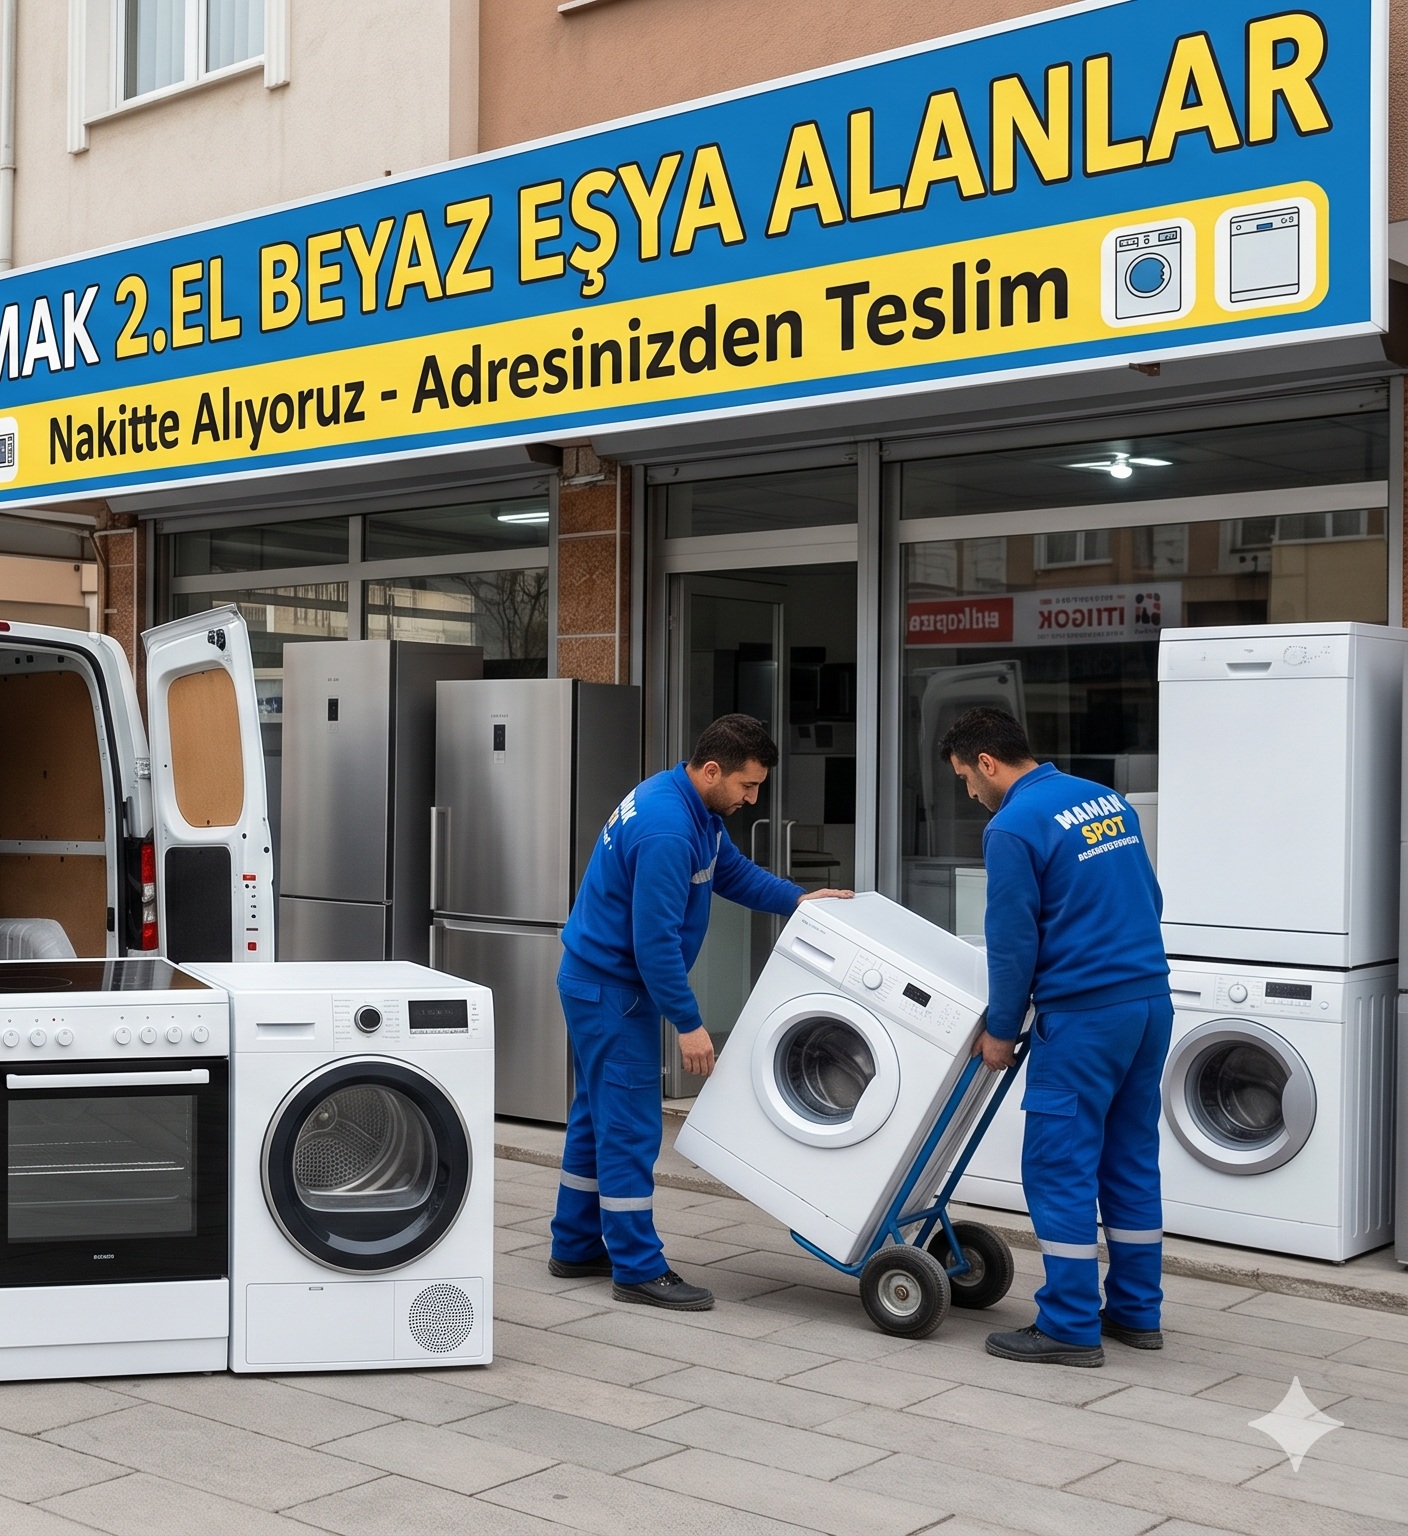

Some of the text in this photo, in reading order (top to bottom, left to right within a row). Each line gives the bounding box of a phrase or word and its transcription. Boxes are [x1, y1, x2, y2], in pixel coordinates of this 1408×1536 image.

[114, 255, 242, 360] 2.EL
[258, 194, 493, 333] BEYAZ
[517, 143, 747, 298] EŞYA
[765, 10, 1332, 238] ALANLAR
[49, 402, 179, 465] Nakitte
[191, 380, 365, 451] Alıyoruz
[412, 304, 803, 414] Adresinizden
[825, 258, 1069, 351] Teslim
[1081, 815, 1126, 845] SPOT
